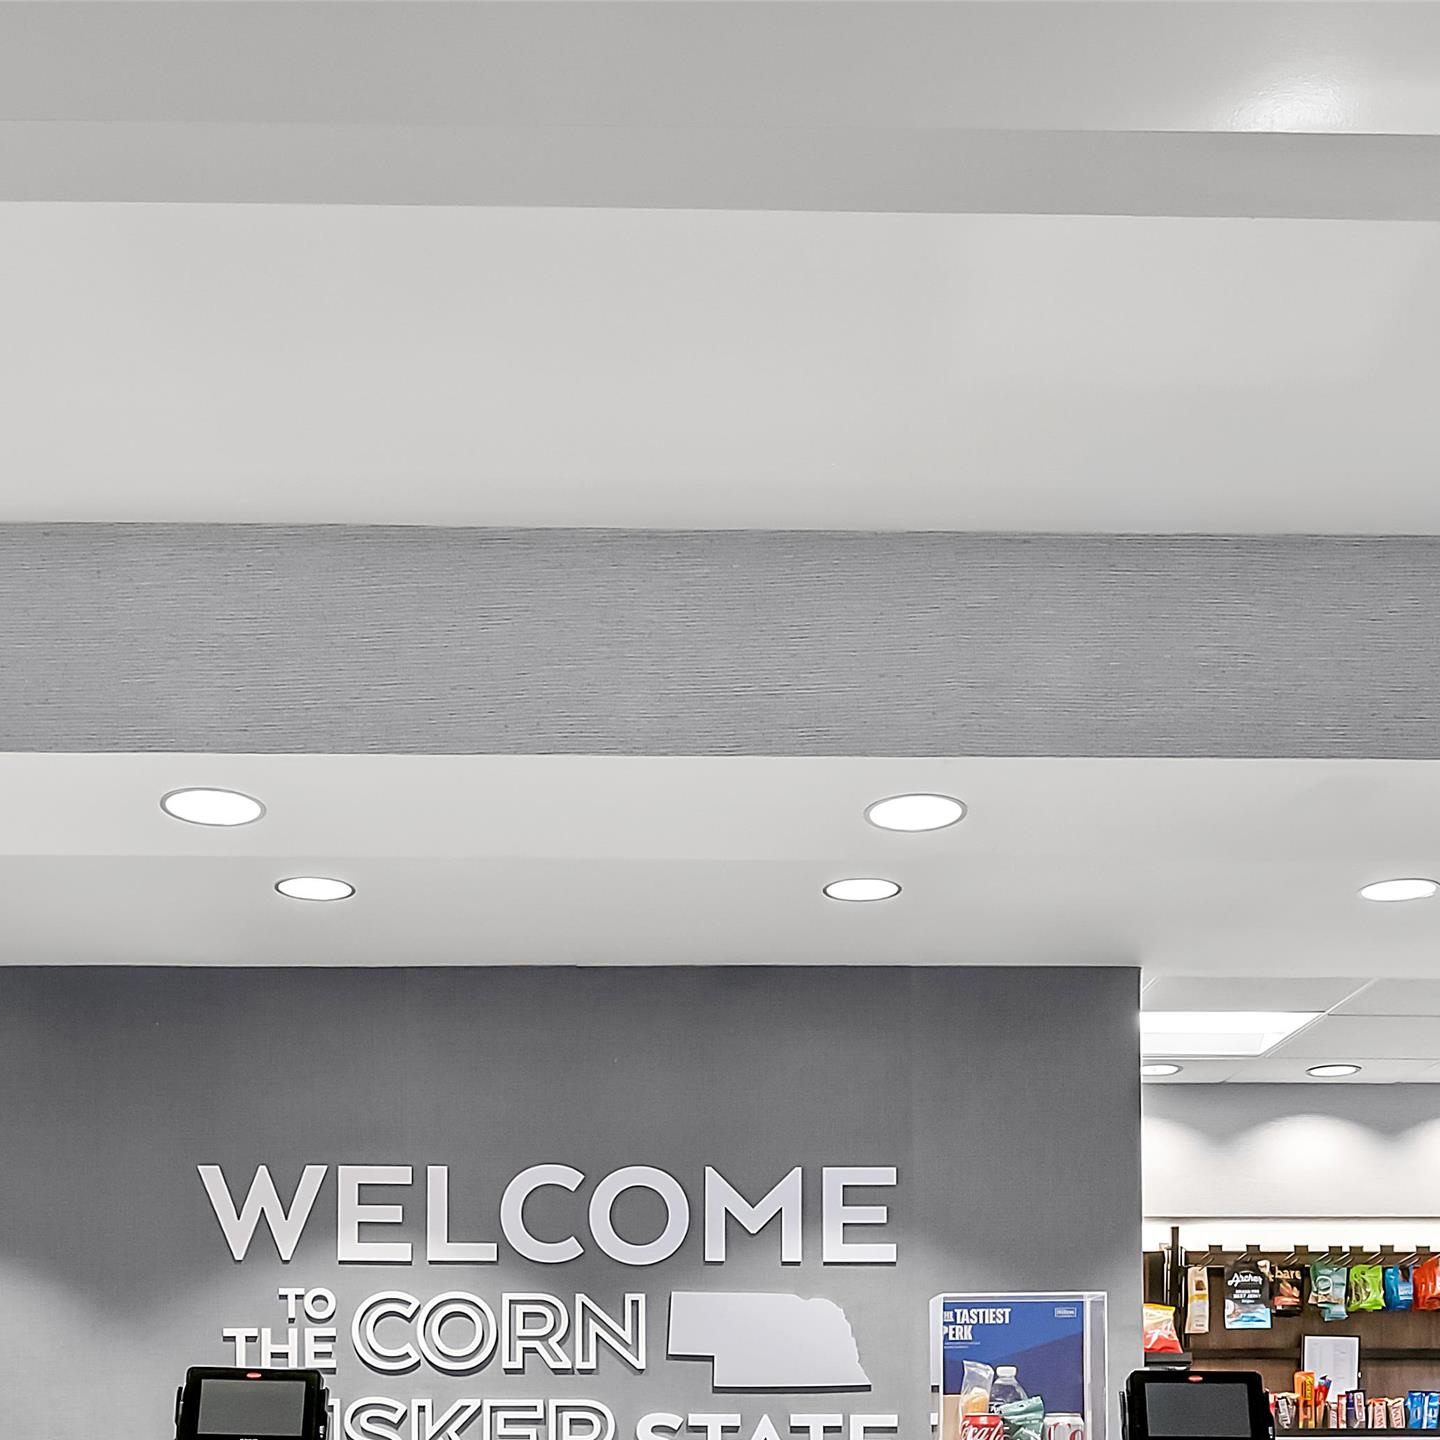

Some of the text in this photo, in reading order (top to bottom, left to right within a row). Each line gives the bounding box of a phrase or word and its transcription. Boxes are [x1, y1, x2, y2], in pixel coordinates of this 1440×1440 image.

[197, 1163, 899, 1266] WELCOME
[1227, 1272, 1263, 1288] Archer
[1275, 1266, 1302, 1280] bare
[278, 1288, 337, 1322] TO
[943, 1307, 1012, 1325] HE TASTIEST
[350, 1290, 647, 1372] CORN
[222, 1327, 337, 1370] THE
